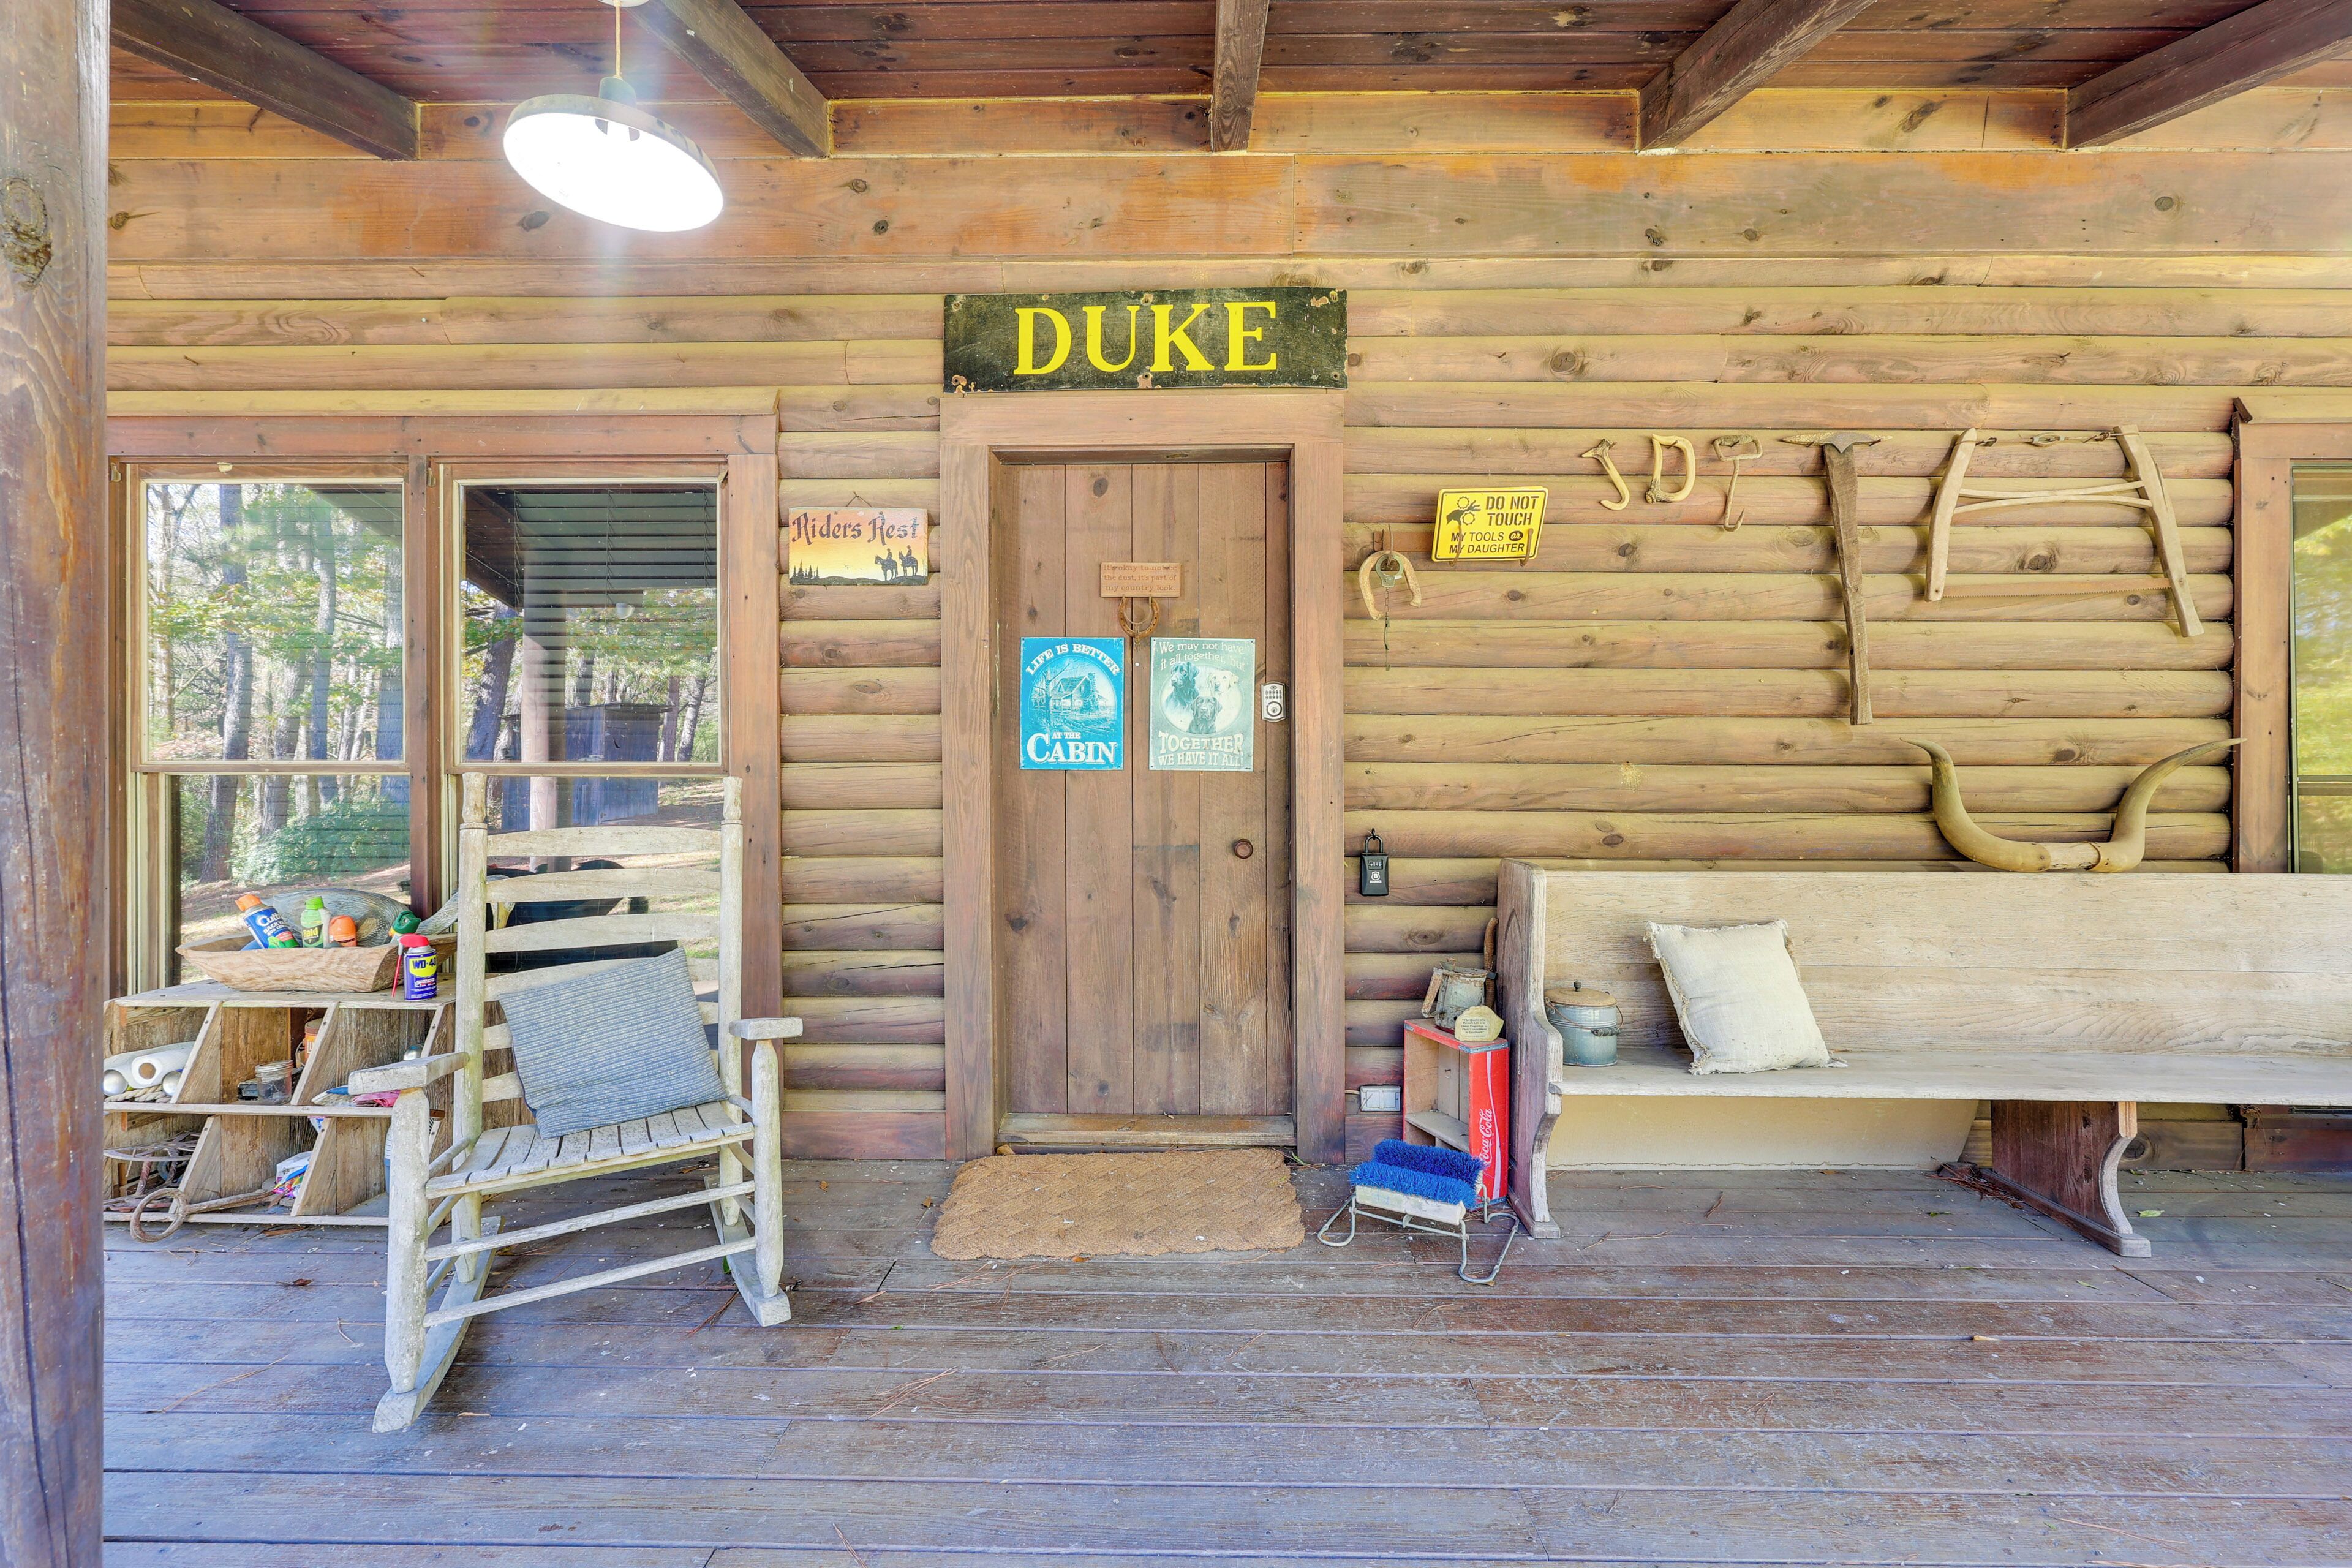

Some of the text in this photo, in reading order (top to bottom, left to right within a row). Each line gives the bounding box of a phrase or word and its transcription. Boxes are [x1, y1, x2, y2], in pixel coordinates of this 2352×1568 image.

[1013, 301, 1276, 375] DUKE
[1486, 496, 1539, 510] DO NOT
[1487, 512, 1532, 526] TOUCH
[791, 512, 919, 546] Riders Rest
[1451, 532, 1522, 542] MY TOOLS or
[1449, 543, 1525, 554] MY DAUGHTER
[1159, 641, 1174, 654] We
[1177, 643, 1199, 651] may
[1221, 642, 1245, 654] have
[1025, 643, 1122, 676] LIFE IS BETTER
[1161, 652, 1245, 671] it all together, but
[1027, 733, 1117, 764] CABIN
[1158, 731, 1243, 756] TOGETHER
[1158, 754, 1174, 766] WE
[1177, 751, 1205, 765] HAVE
[1208, 752, 1219, 765] IT
[257, 913, 282, 927] Cutt
[412, 957, 436, 969] WD-40
